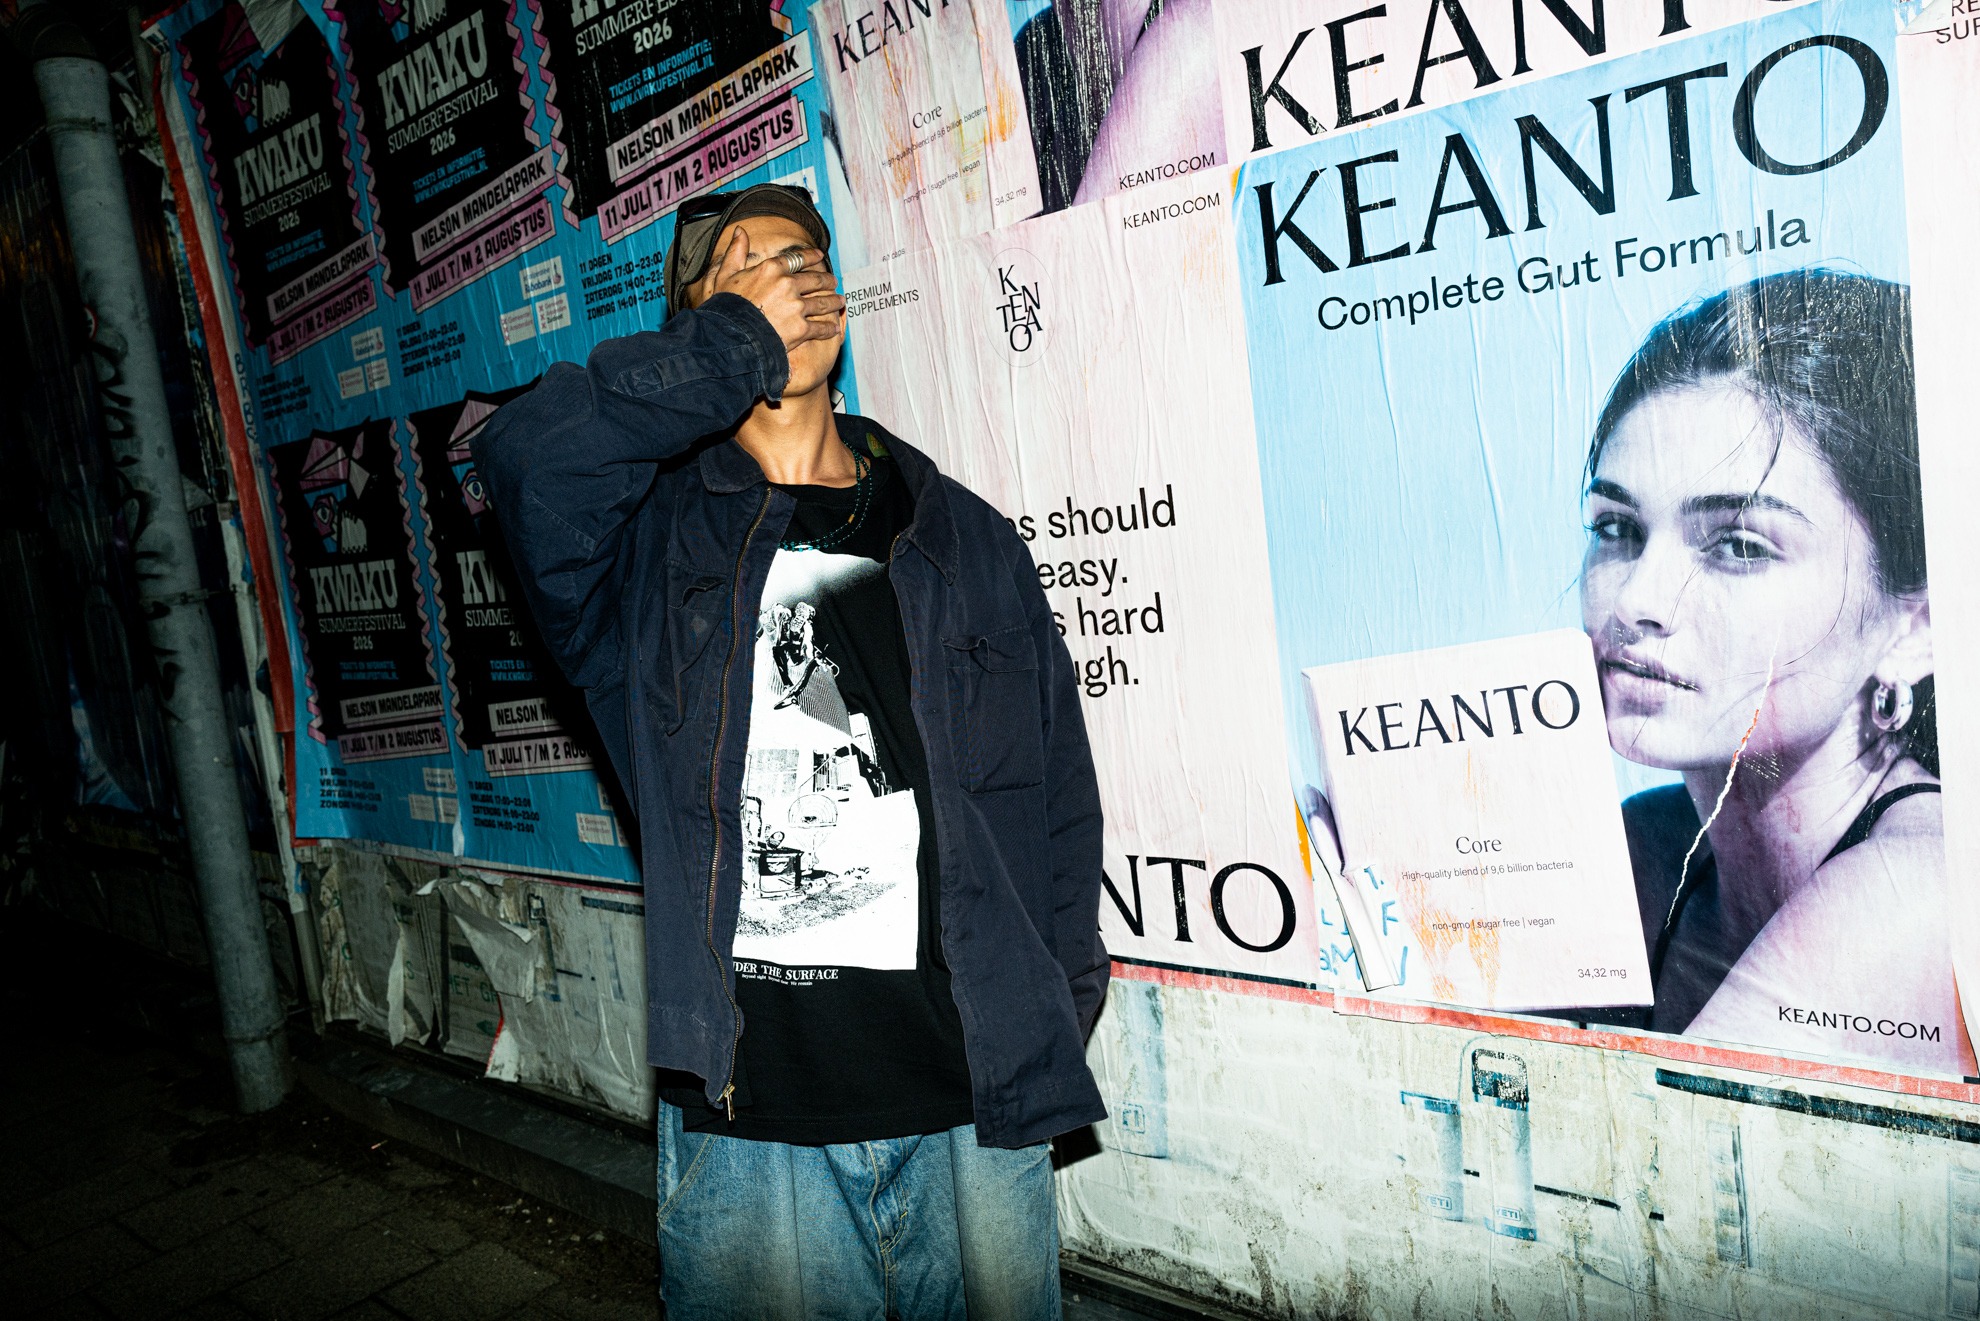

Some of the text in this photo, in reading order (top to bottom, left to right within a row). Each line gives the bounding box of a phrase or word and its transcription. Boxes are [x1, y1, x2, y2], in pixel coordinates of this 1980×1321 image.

[633, 17, 673, 54] 2026
[832, 0, 950, 73] KEAN
[377, 9, 488, 130] KWAKU
[608, 39, 712, 98] TICKETS EN INFORMATIE:
[609, 54, 715, 113] WWW.KWAKUFESTIVAL.NL
[387, 79, 498, 154] SUMMERFESTIVAL
[616, 45, 800, 169] NELSON MANDELAPARK
[912, 105, 943, 129] Core
[930, 134, 937, 142] of
[963, 105, 988, 123] bacteria
[233, 112, 324, 207] KWAKU
[430, 127, 456, 156] 2026
[604, 109, 794, 229] 11 JULI T/M 2 AUGUSTUS
[931, 176, 947, 191] sugar
[947, 170, 959, 182] free
[962, 159, 981, 174] vegan
[1119, 151, 1215, 190] KEANTO.COM
[1252, 34, 1891, 287] KEANTO
[243, 171, 332, 228] SUMMERFESTIVAL
[421, 156, 546, 251] NELSON MANDELAPARK
[994, 185, 1027, 207] 34,32 mg
[1123, 192, 1221, 230] KEANTO.COM
[278, 210, 300, 232] 2026
[413, 208, 546, 300] 11 JULI T/M 2 AUGUSTUS
[579, 252, 613, 274] 11 DAGEN
[1316, 208, 1811, 331] Complete Gut Formula
[274, 284, 304, 314] NELSON
[305, 241, 370, 294] MANDELAPARK
[581, 269, 613, 289] VRIJDAG
[584, 282, 623, 305] ZATERDAG
[845, 281, 892, 304] PREMIUM
[317, 313, 325, 329] 2
[324, 284, 369, 323] AUGUSTUS
[587, 302, 616, 320] ZONDAG
[847, 289, 920, 318] SUPPLEMENTS
[1047, 483, 1176, 539] should
[309, 558, 399, 614] KWAKU
[1036, 557, 1128, 597] easy.
[318, 613, 406, 634] SUMMERFESTIVAL
[1076, 591, 1164, 637] hard
[352, 635, 374, 651] 2026
[346, 690, 443, 718] NELSON MANDELAPARK
[496, 705, 538, 725] NELSON
[1338, 679, 1581, 756] KEANTO
[367, 735, 387, 753] T/M
[389, 735, 395, 749] 2
[396, 727, 442, 746] AUGUSTUS
[487, 749, 497, 765] 11
[500, 748, 522, 764] JULI
[524, 744, 550, 764] T/M
[553, 743, 560, 760] 2
[1455, 836, 1502, 855] Core
[1402, 859, 1574, 882] High-quality blend of 9,6 billion bacteria
[1432, 917, 1555, 932] non-gmo sugar free vegan
[761, 964, 782, 978] THE
[785, 969, 839, 980] SURFACE
[1577, 967, 1627, 980] 34,32 mg
[1778, 1005, 1941, 1043] KEANTO.COM
